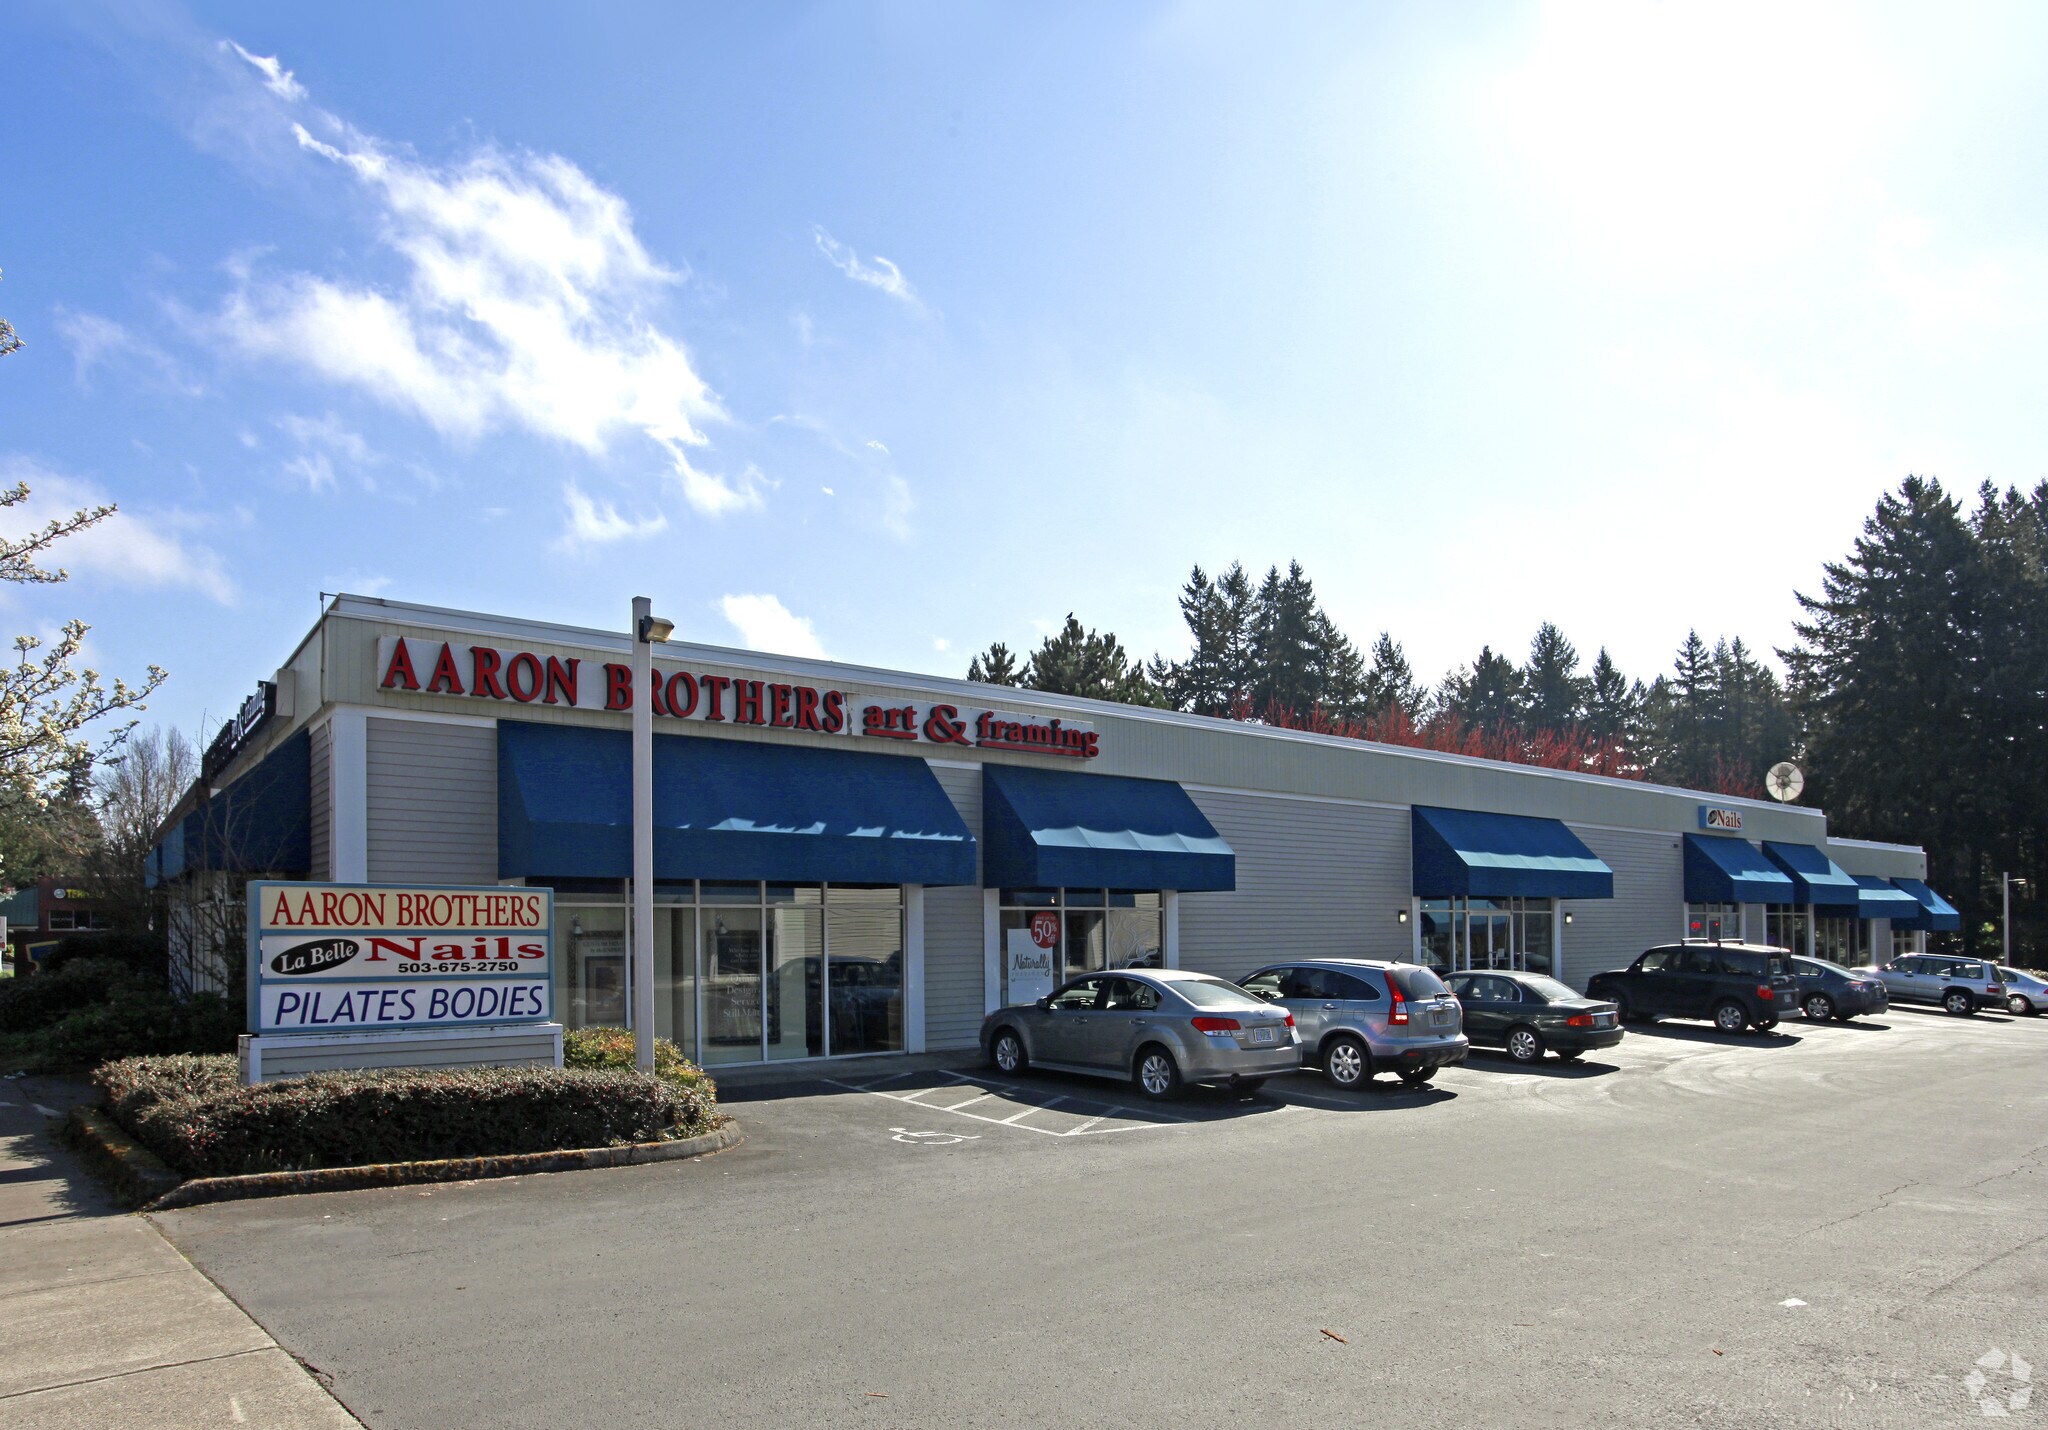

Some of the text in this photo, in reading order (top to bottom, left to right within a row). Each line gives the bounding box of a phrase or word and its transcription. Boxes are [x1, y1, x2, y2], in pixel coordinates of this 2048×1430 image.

[381, 636, 845, 734] AARON BROTHERS
[863, 704, 1100, 757] art & framing
[1716, 809, 1742, 829] Nails
[269, 890, 540, 927] AARON BROTHERS
[280, 937, 546, 973] La Belle Nails
[398, 961, 519, 974] 503-675-2750
[1012, 953, 1051, 977] Naturally
[275, 985, 544, 1026] PILATES BODIES
